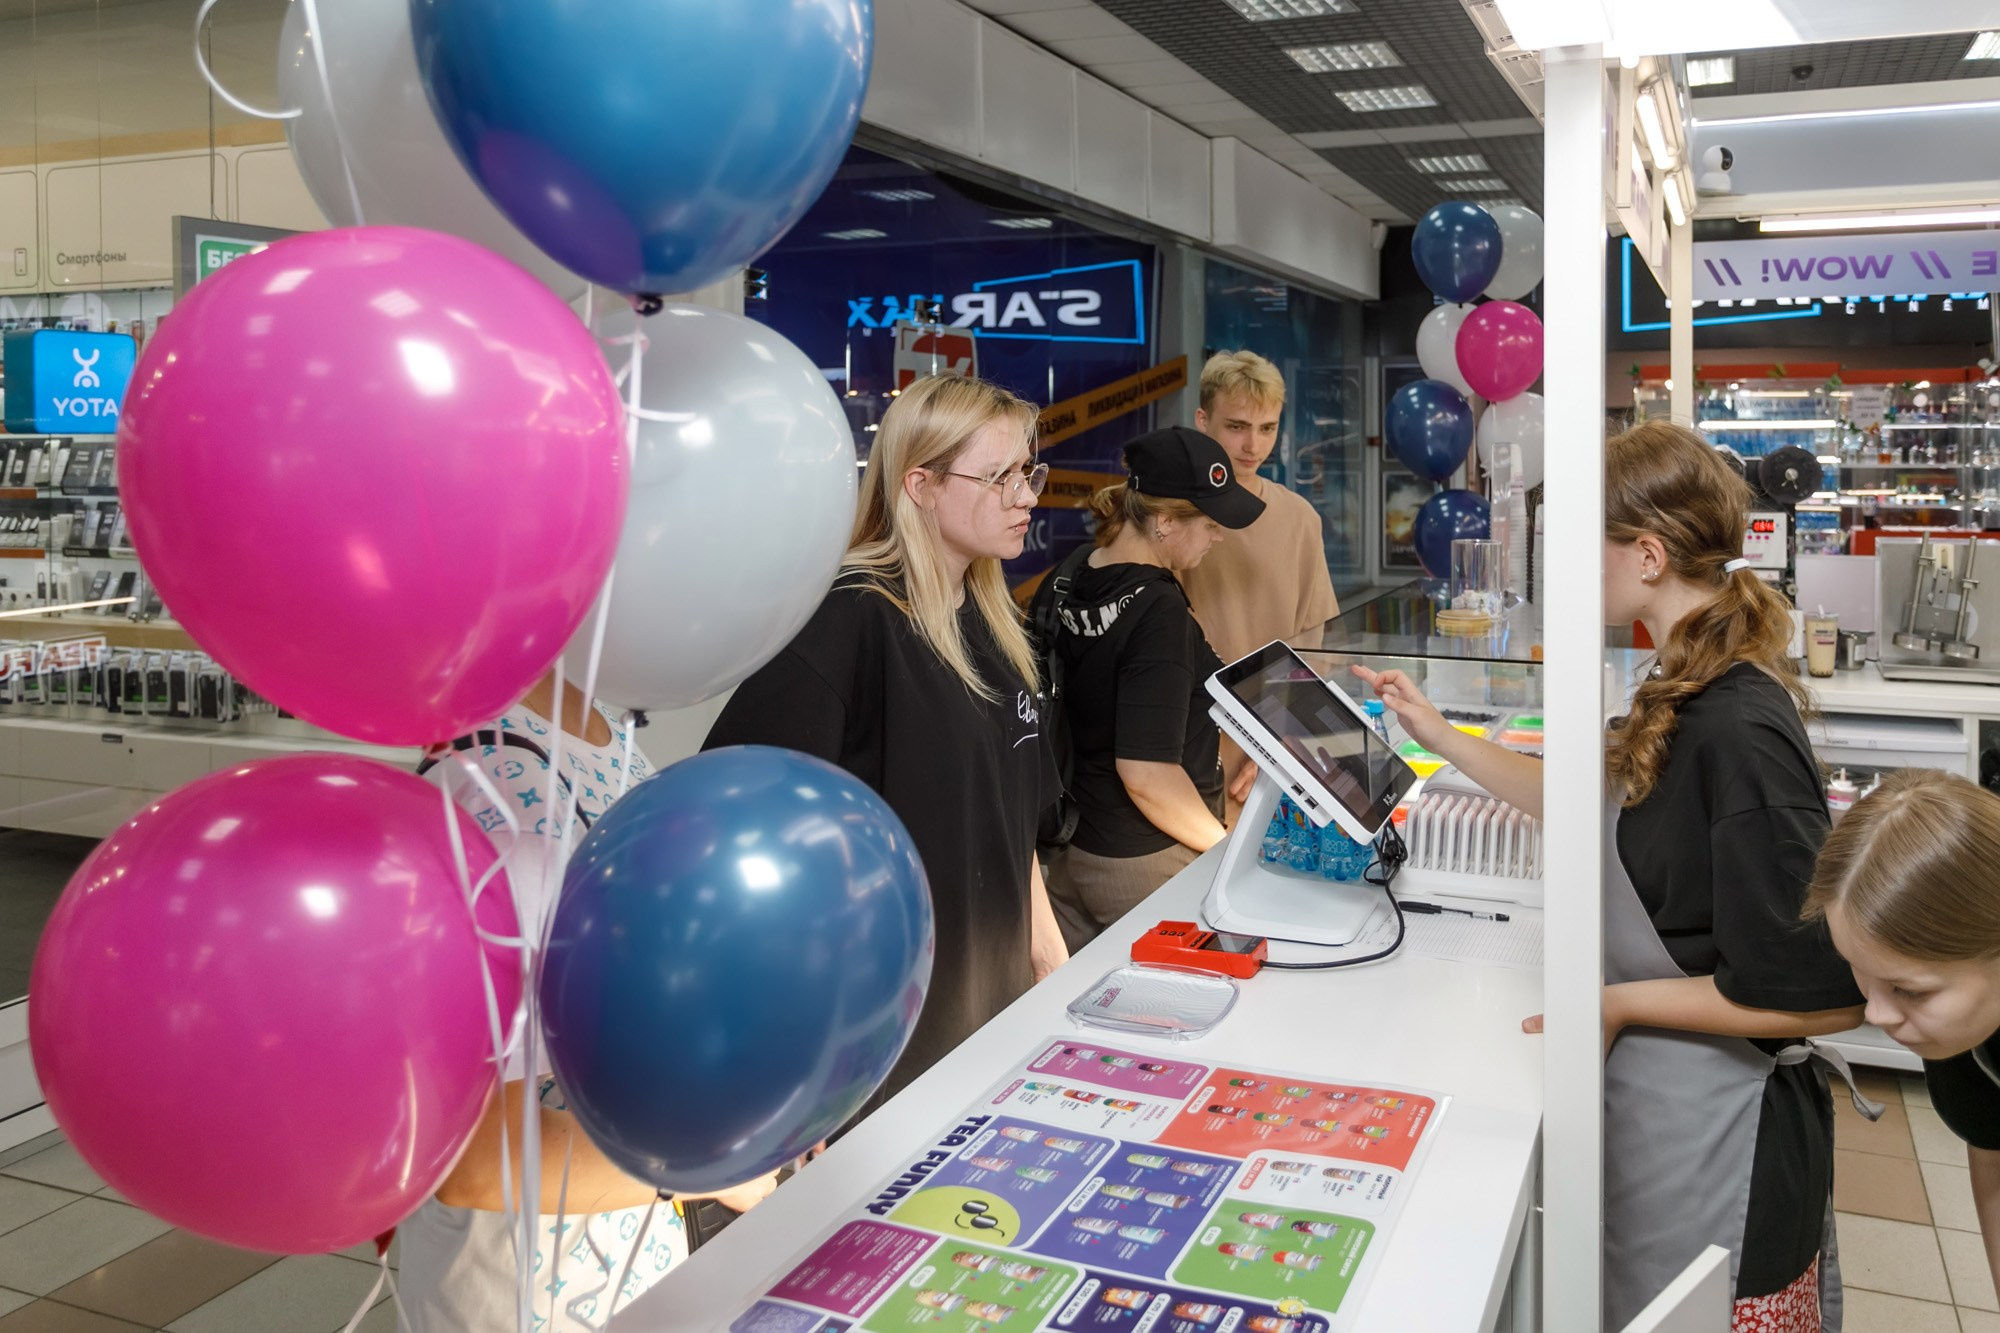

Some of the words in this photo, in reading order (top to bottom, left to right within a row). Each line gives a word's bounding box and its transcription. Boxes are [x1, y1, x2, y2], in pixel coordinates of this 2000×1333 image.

[57, 250, 127, 268] Смартфоны
[207, 249, 245, 268] БЕ
[53, 397, 119, 417] YOTA
[936, 1113, 992, 1147] TEA
[858, 1149, 952, 1215] FUNNY
